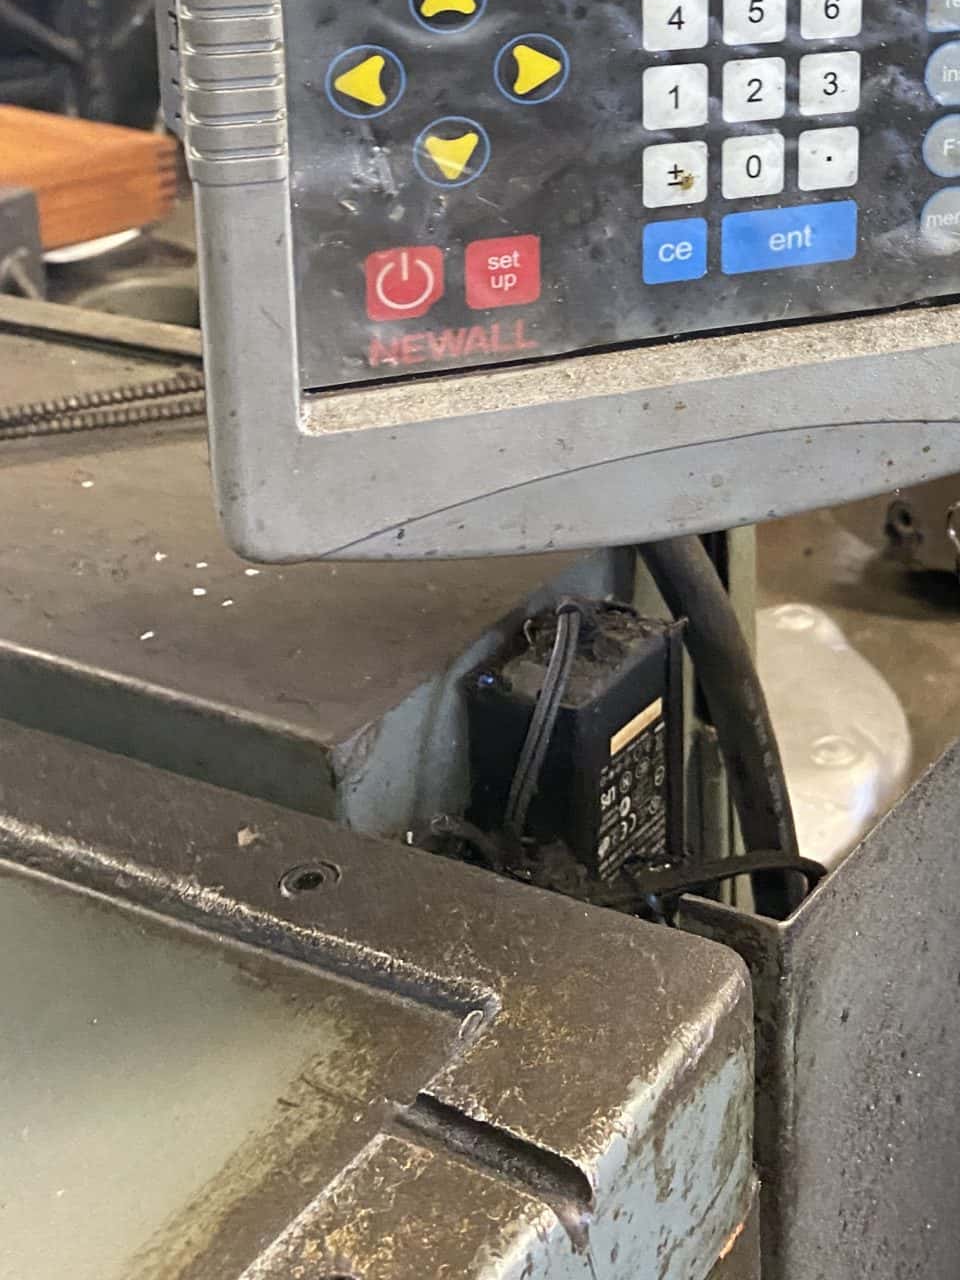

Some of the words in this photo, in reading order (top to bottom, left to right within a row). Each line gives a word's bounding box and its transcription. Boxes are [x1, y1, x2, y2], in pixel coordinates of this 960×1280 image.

[667, 6, 685, 31] 4
[747, 0, 765, 24] 5
[747, 78, 763, 102] 2
[822, 71, 839, 96] 3
[669, 85, 680, 109] 1
[746, 154, 762, 179] 0
[769, 224, 812, 252] ent
[487, 251, 520, 270] set
[658, 240, 693, 263] ce
[491, 273, 517, 291] up
[368, 319, 539, 368] NEWALL
